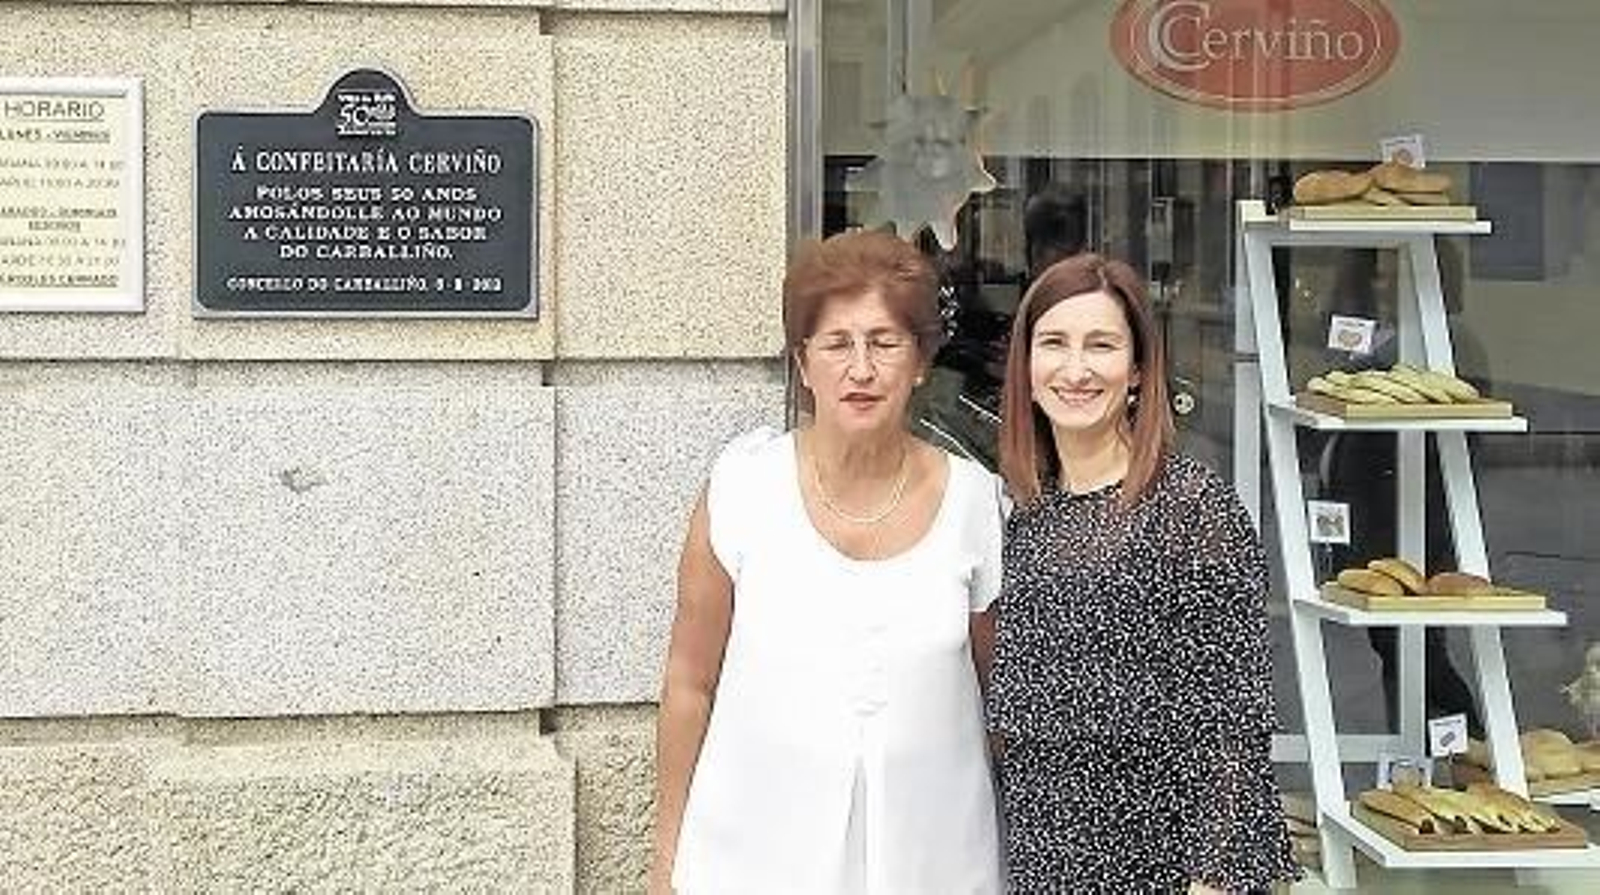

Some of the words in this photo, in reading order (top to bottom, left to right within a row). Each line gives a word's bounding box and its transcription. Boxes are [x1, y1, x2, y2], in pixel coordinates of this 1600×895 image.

[1149, 1, 1365, 72] Cerviño
[4, 99, 105, 119] HORARIO
[255, 147, 400, 173] CONFEITARÍA
[409, 147, 503, 174] CERVIÑO
[256, 185, 324, 201] POLOS
[331, 186, 382, 201] SEUS
[391, 187, 414, 201] 50
[421, 187, 478, 201] ANOS
[391, 206, 420, 221] AO
[428, 206, 503, 222] MUNDO
[243, 226, 258, 240] A
[265, 226, 370, 241] CALIDADE
[376, 227, 391, 240] E
[397, 227, 412, 240] O
[418, 227, 488, 241] SABOR
[279, 244, 309, 259] DO
[226, 277, 304, 292] CONCELLO
[308, 278, 329, 292] DO
